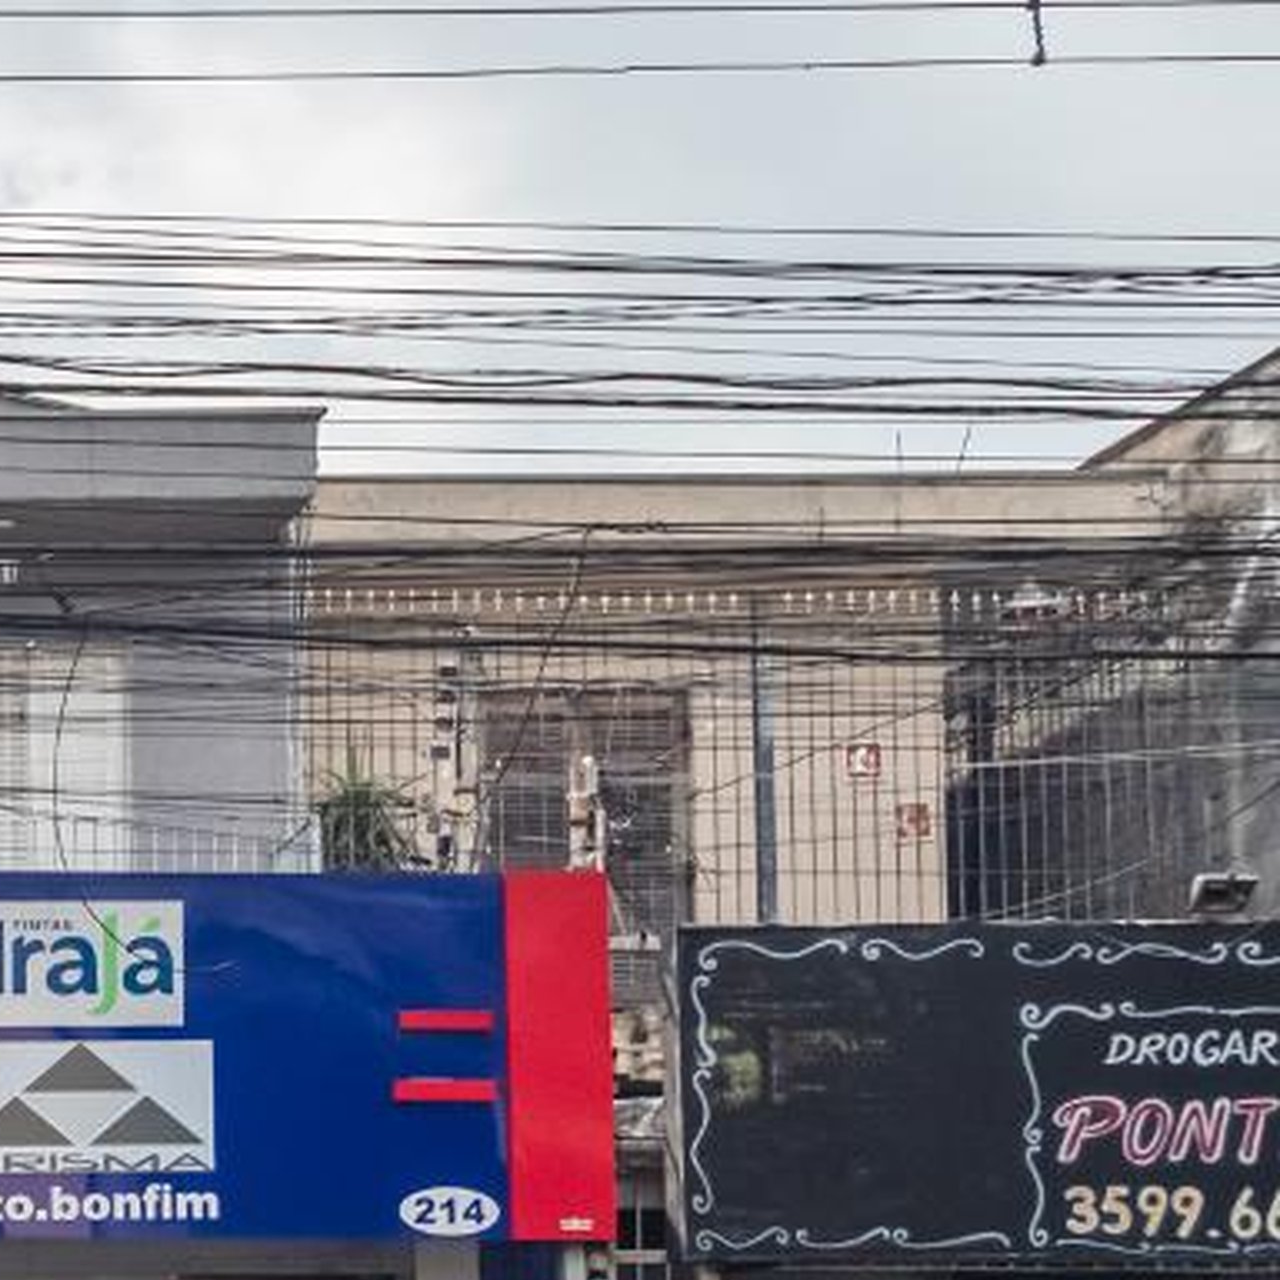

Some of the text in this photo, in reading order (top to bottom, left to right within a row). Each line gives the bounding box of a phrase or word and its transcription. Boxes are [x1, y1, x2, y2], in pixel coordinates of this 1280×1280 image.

[1104, 1030, 1279, 1066] DROGAR
[1052, 1095, 1280, 1165] PONT
[413, 1196, 485, 1225] 214
